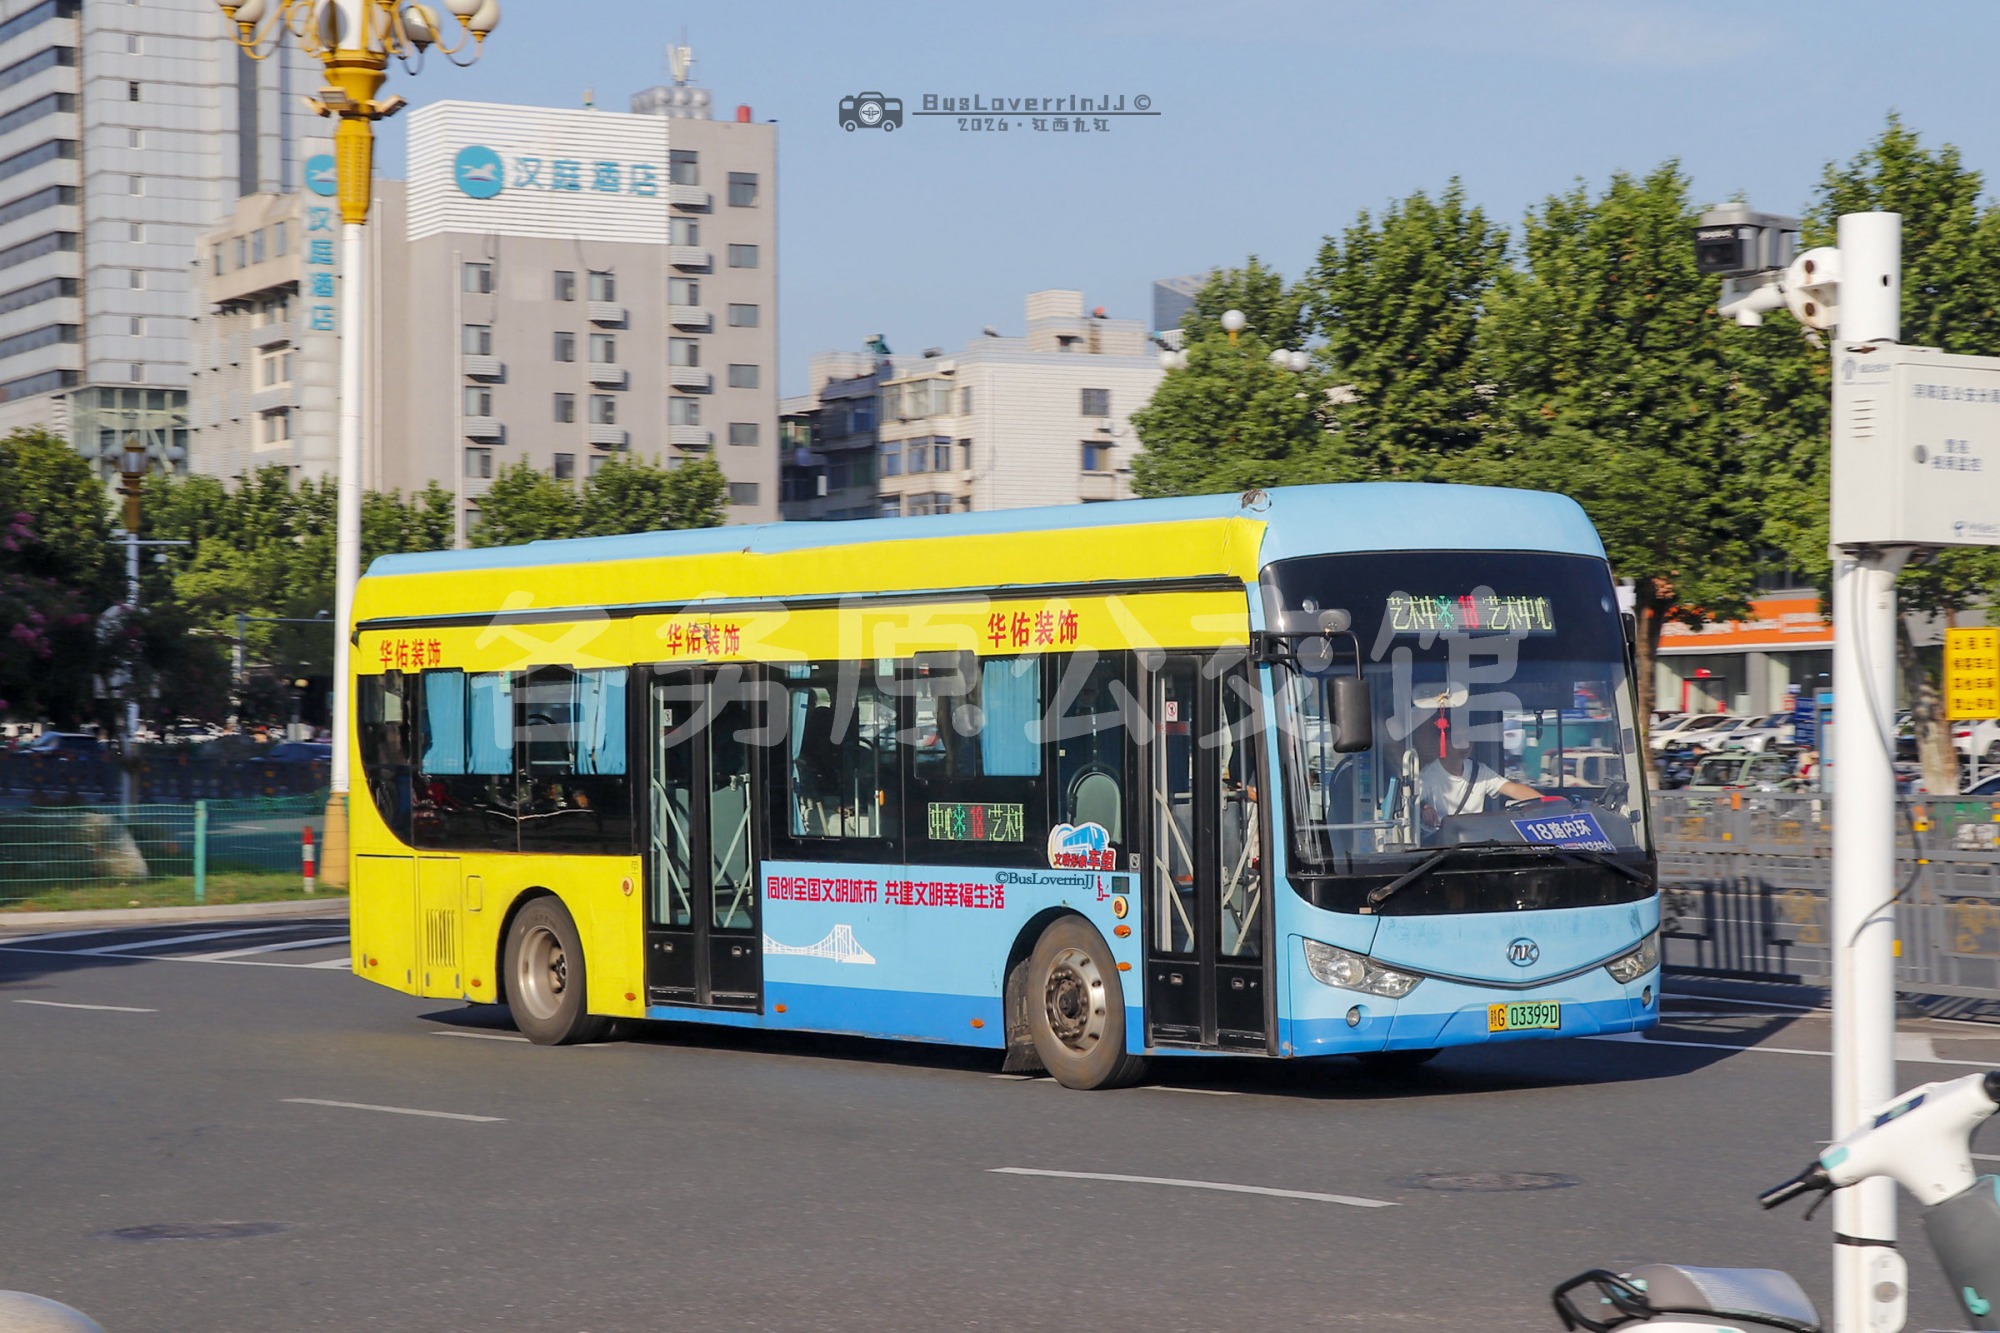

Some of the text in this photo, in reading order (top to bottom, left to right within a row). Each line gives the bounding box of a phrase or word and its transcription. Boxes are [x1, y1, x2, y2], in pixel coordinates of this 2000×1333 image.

[513, 157, 658, 197] 汉庭酒店
[307, 206, 335, 332] 汉庭酒店
[988, 608, 1079, 649] 华佑装饰
[1458, 595, 1479, 630] 18
[380, 638, 441, 669] 华佑装饰
[667, 621, 741, 656] 华佑装饰
[970, 805, 984, 840] 18
[1526, 818, 1592, 841] 18路内环
[767, 876, 1005, 909] 同创全国文明城市 共建文明幸福生活
